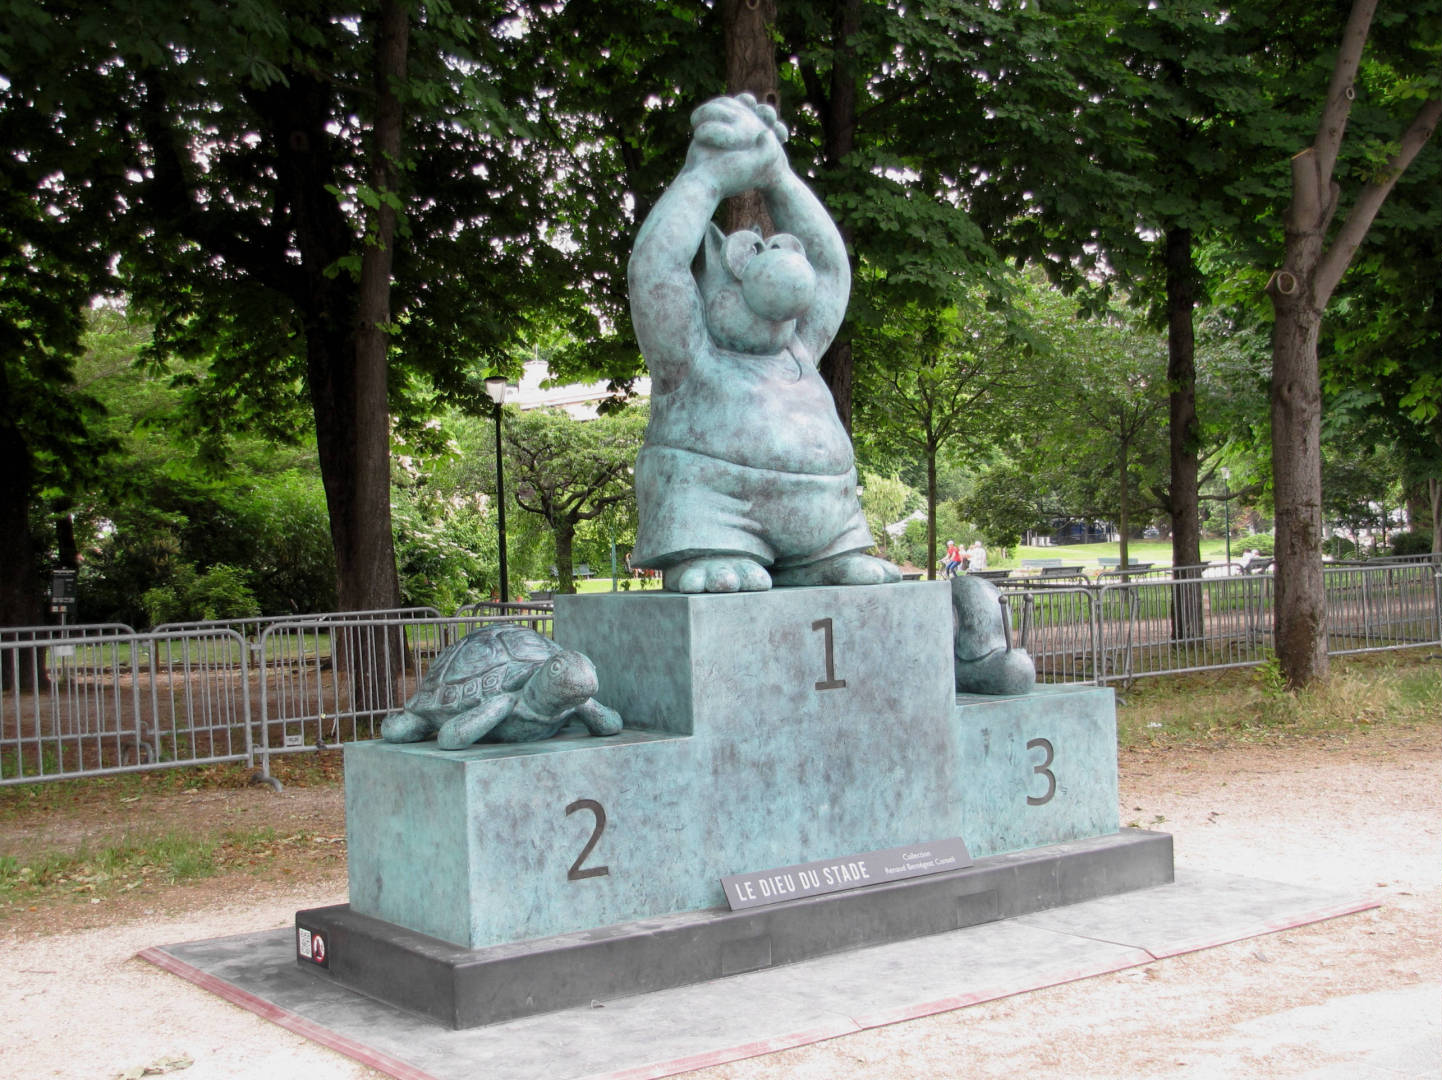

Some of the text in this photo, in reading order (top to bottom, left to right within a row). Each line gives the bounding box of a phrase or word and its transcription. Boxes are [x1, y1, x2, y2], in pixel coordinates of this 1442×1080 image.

[811, 617, 847, 691] 1
[1025, 737, 1057, 807] 3
[565, 798, 609, 881] 2
[735, 861, 870, 901] LE DIEU DU STADE
